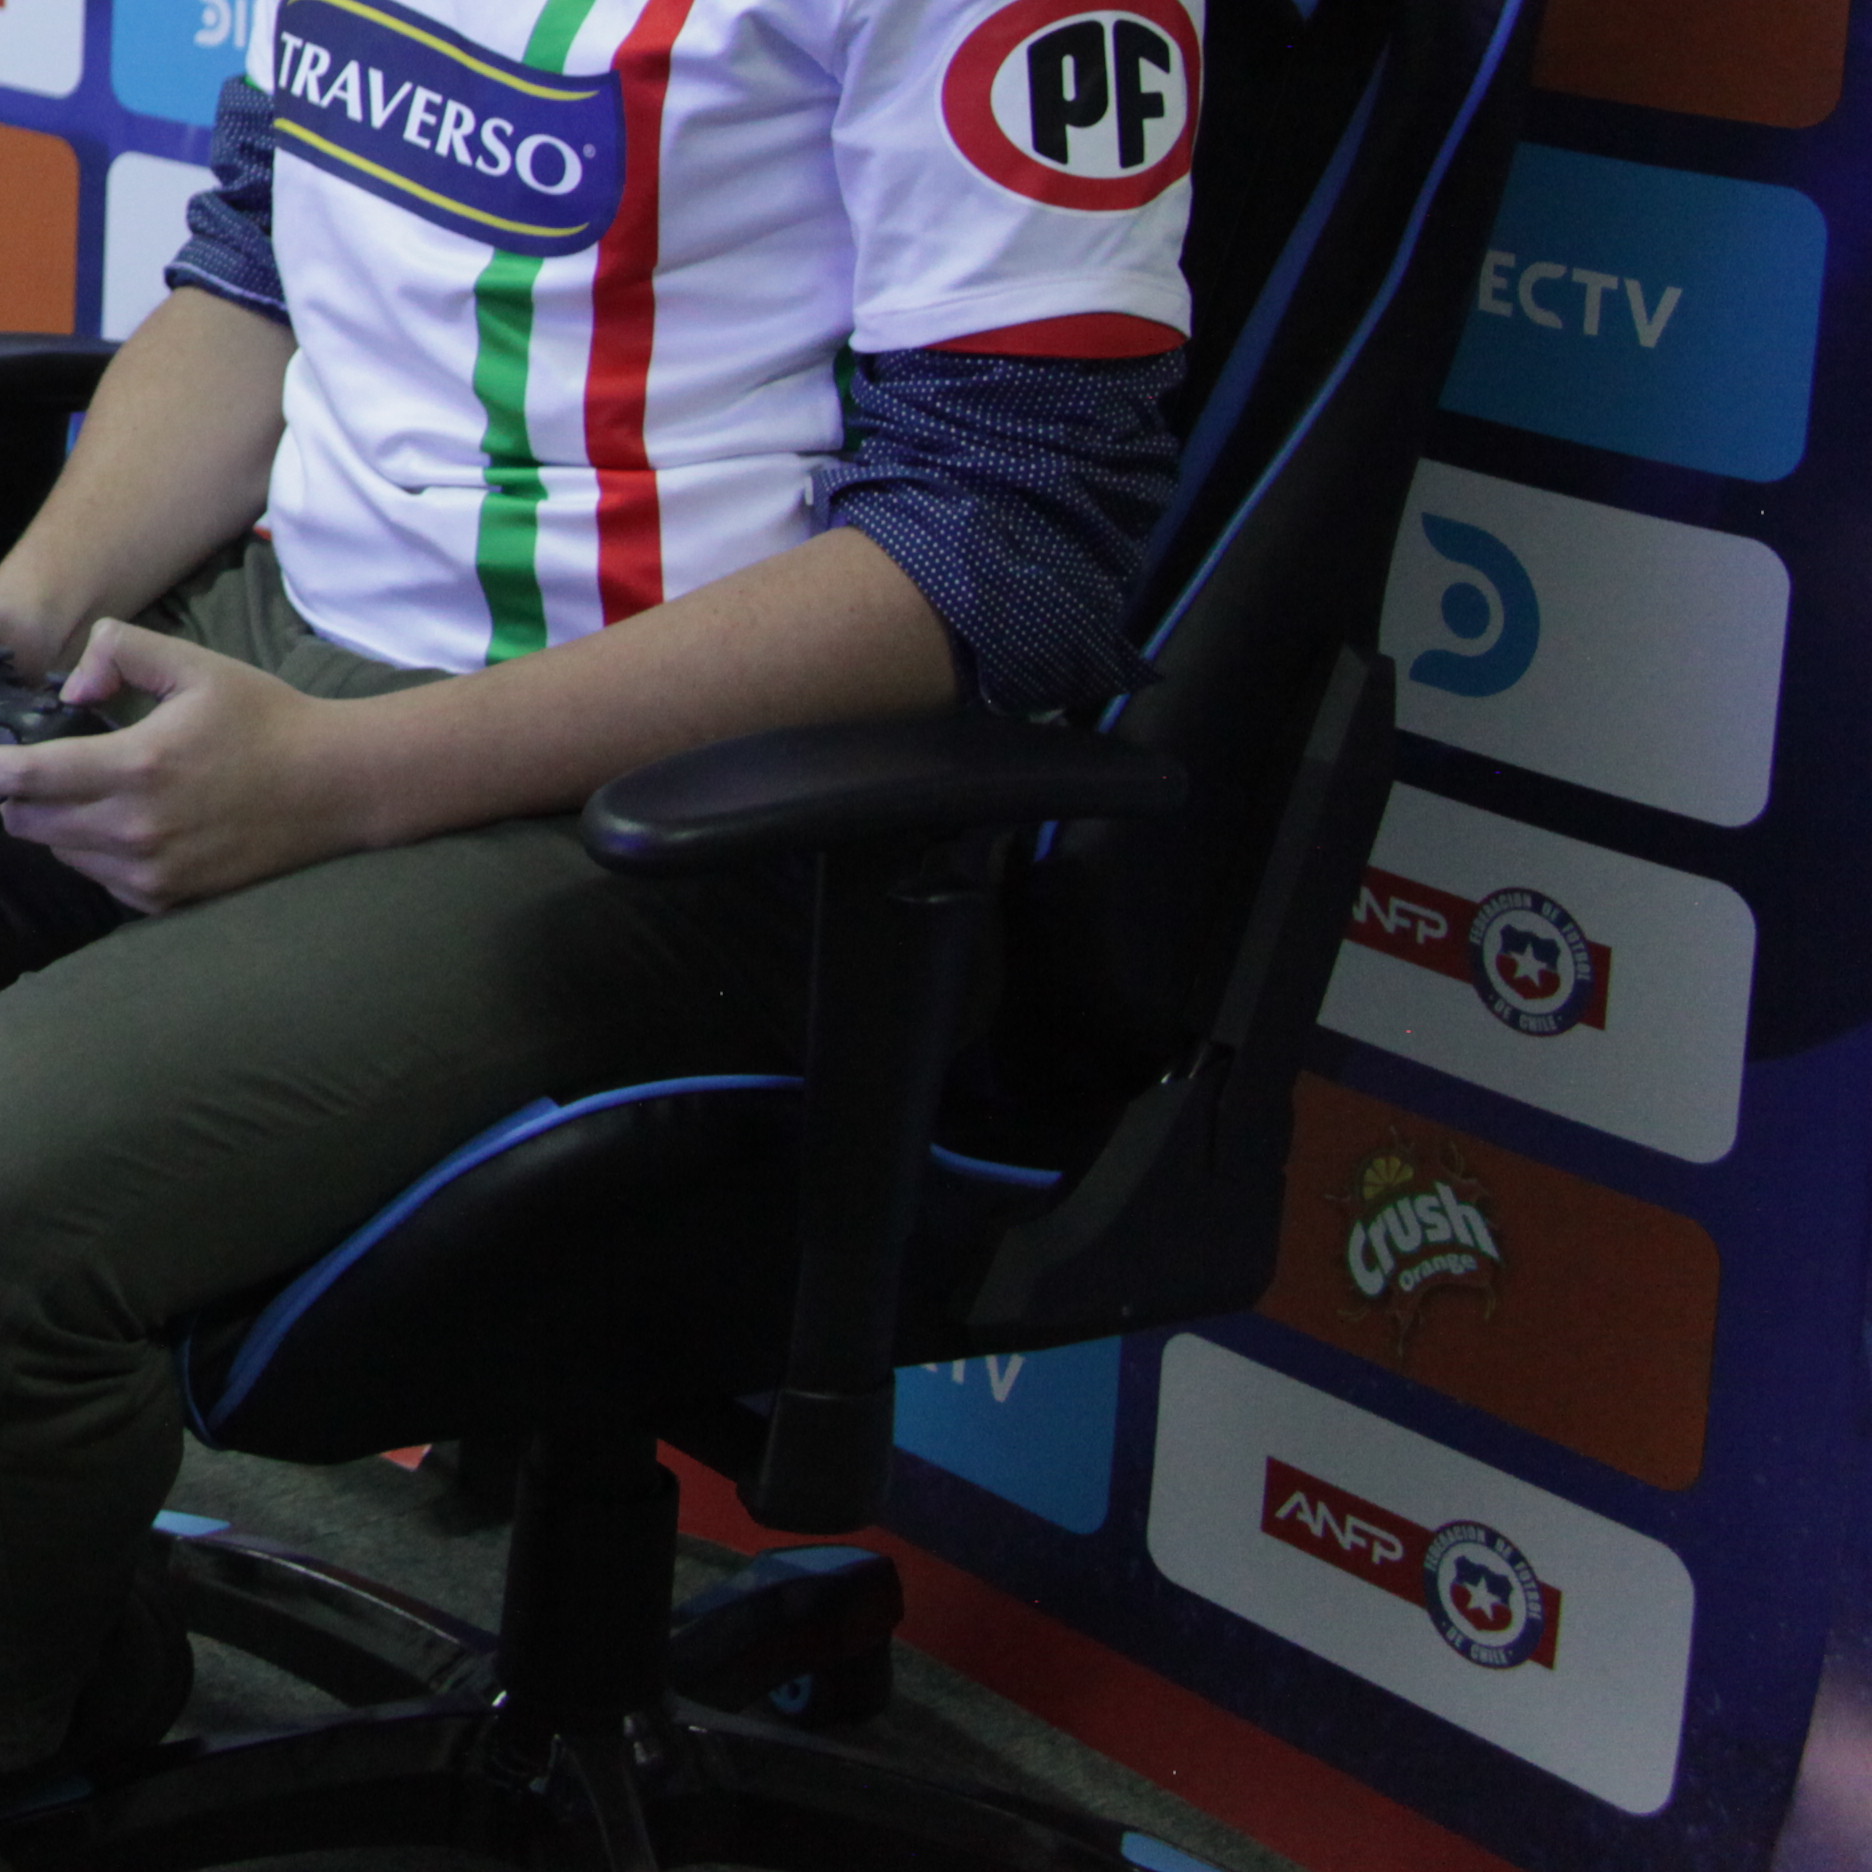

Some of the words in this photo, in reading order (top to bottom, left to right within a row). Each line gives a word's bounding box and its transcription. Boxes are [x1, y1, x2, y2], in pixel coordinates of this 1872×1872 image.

[277, 31, 582, 195] TRAVERSO
[1027, 19, 1172, 170] PF
[1477, 248, 1683, 349] ECTV
[1353, 885, 1448, 945] NFP
[1275, 1490, 1404, 1565] ANFP
